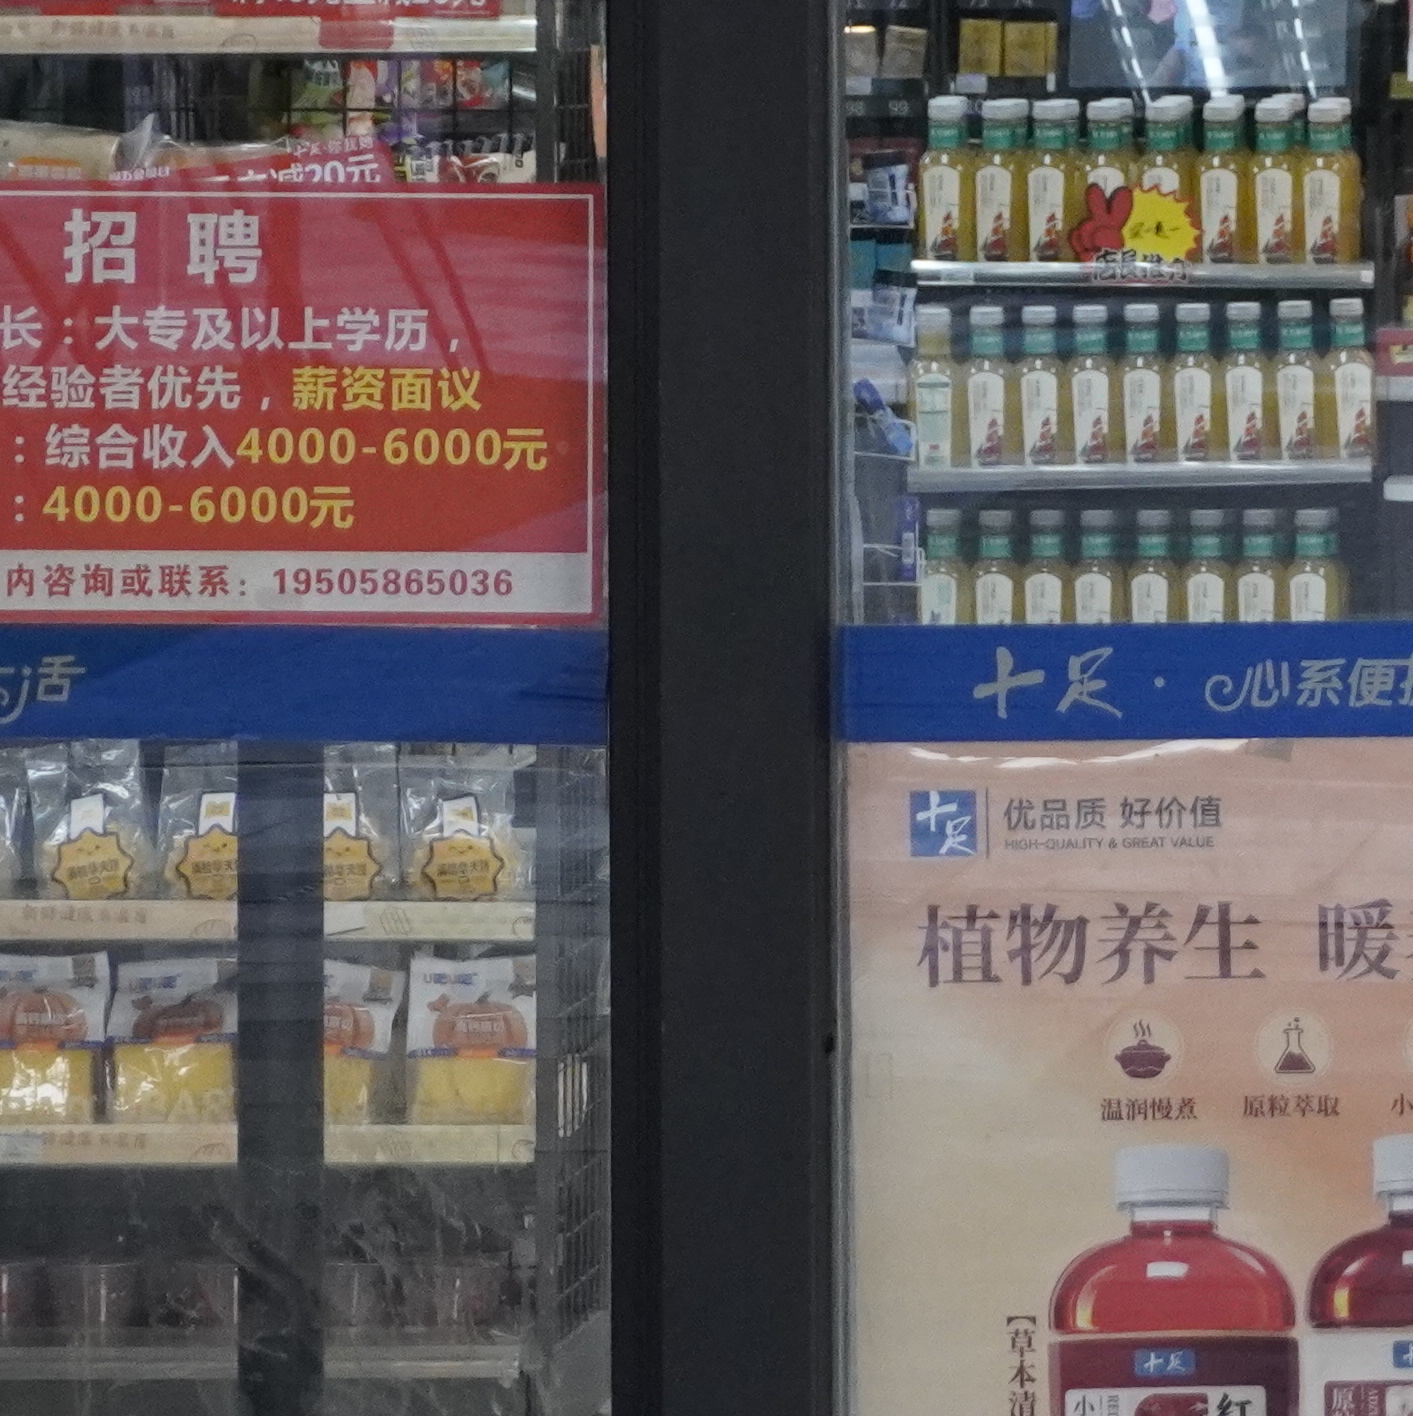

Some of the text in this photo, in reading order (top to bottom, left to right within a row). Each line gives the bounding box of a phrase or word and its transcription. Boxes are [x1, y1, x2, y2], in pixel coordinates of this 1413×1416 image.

[63, 208, 262, 284] 招聘
[6, 563, 513, 598] 内咨询或联系： 19505865036
[973, 645, 1123, 720] 十足
[916, 791, 975, 855] 十足
[1003, 795, 1223, 831] 优品质 好价值
[1005, 834, 1215, 850] HIGH-QUALITY & GREAT VALUE
[917, 901, 1267, 989] 植物养生
[1100, 1096, 1198, 1122] 温润慢煮
[1242, 1094, 1341, 1118] 原粒萃取
